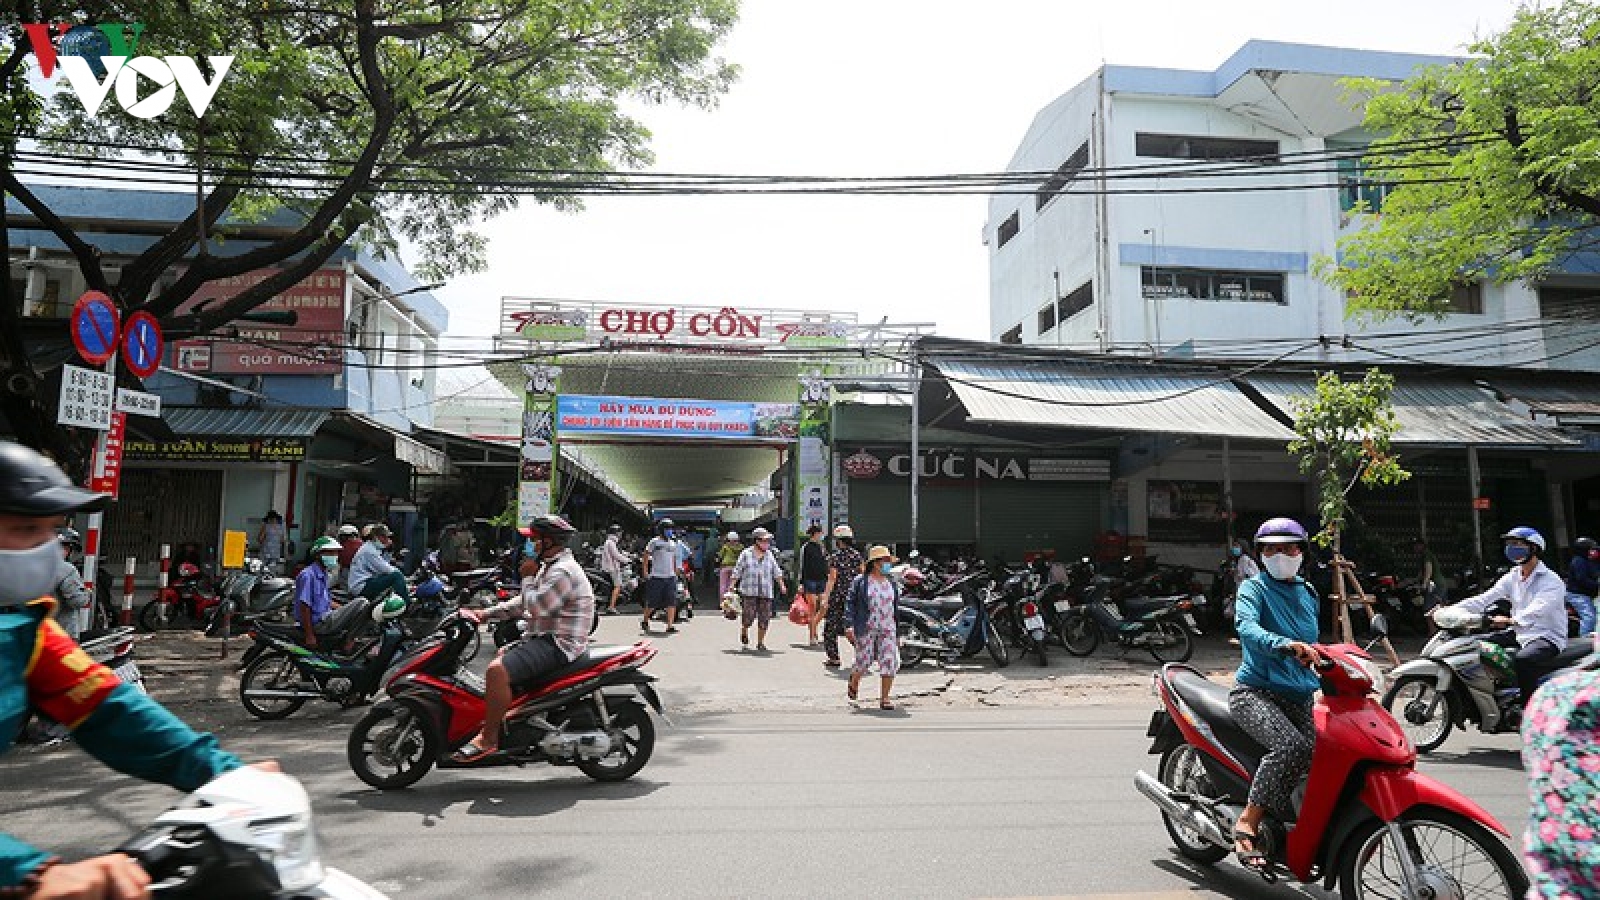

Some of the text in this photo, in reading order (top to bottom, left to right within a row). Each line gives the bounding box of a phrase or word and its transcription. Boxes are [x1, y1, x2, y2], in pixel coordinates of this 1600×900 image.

[600, 309, 675, 340] CHỢ
[689, 306, 763, 338] CỒN
[887, 447, 966, 477] CÚC
[975, 457, 1027, 479] NA
